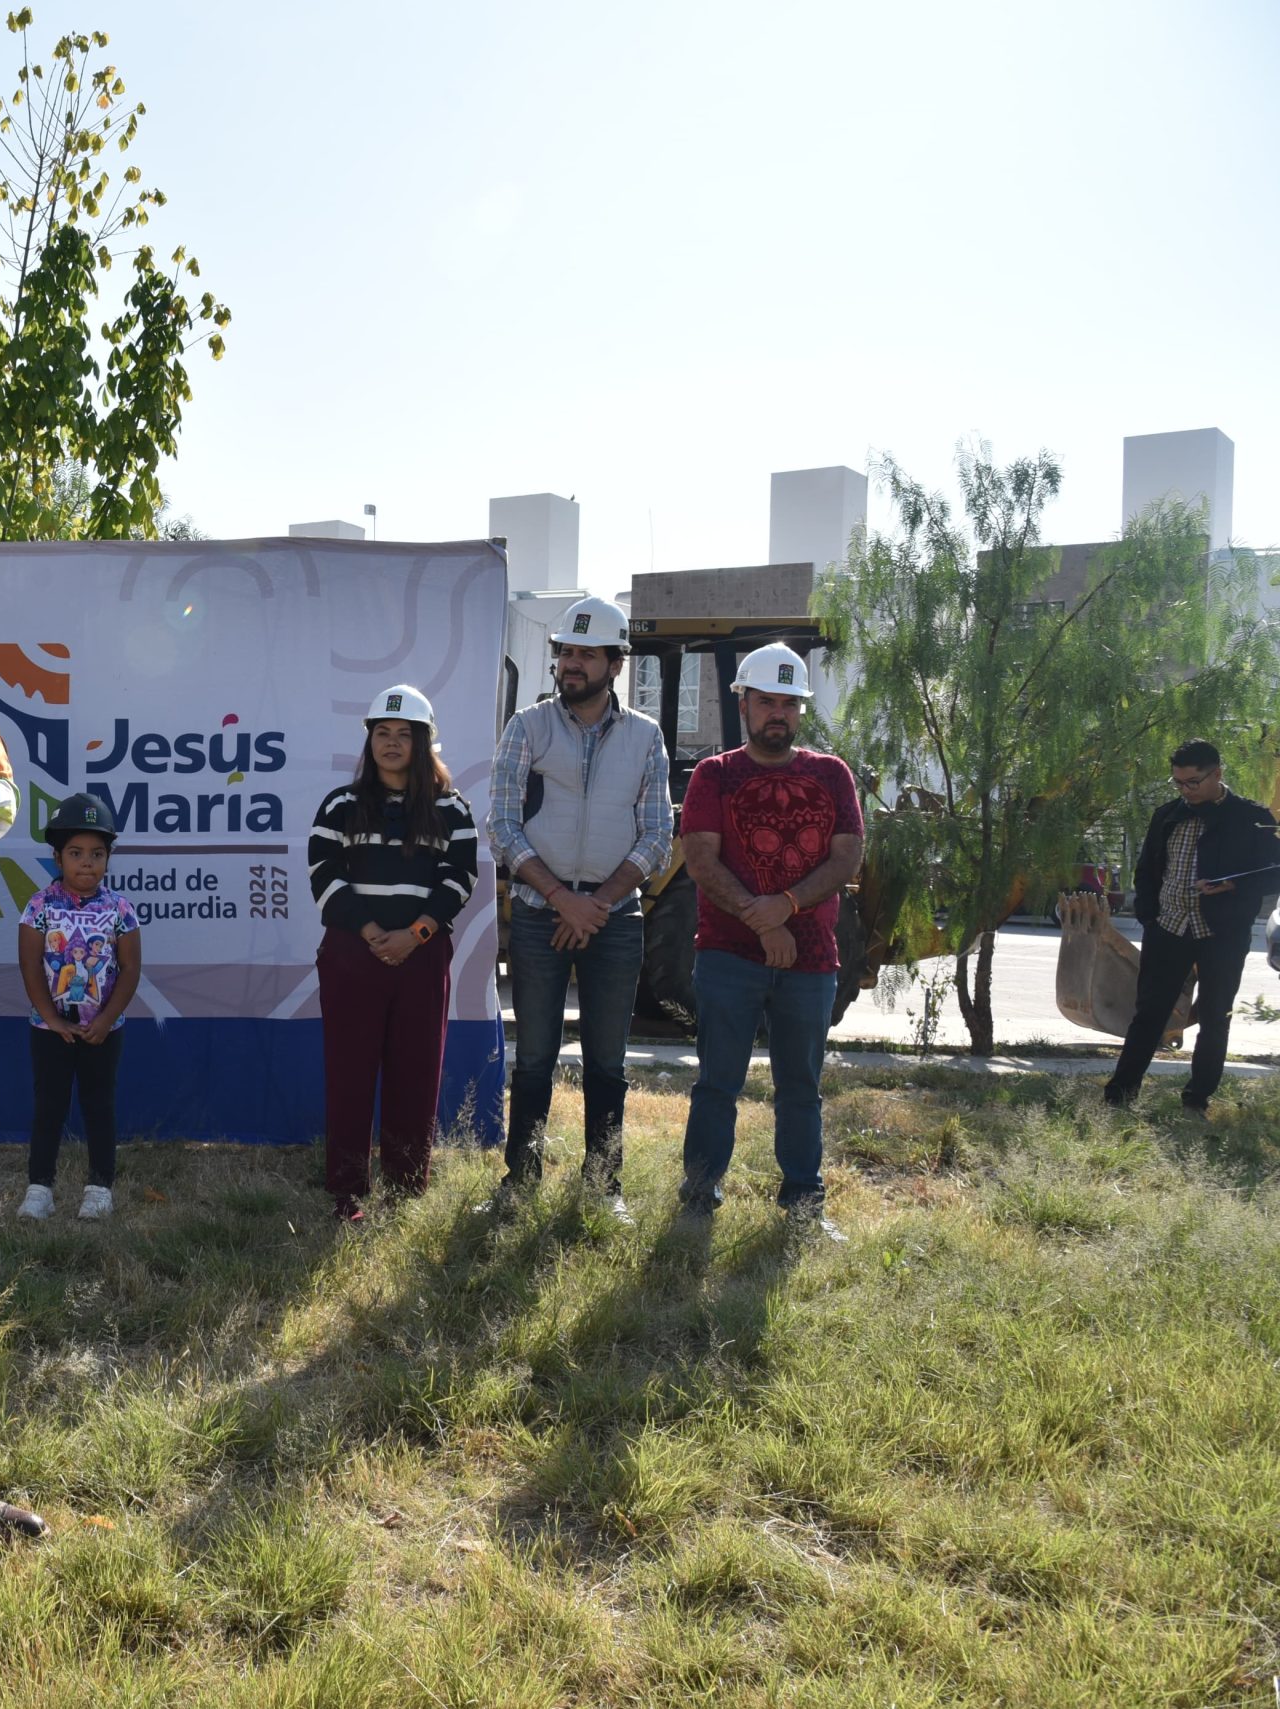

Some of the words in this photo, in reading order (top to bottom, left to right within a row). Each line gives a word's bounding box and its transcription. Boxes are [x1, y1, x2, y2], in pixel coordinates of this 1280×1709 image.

[629, 621, 649, 632] 16C
[86, 713, 287, 774] Jesús
[86, 771, 283, 833] María
[103, 868, 176, 891] iudad
[185, 868, 218, 891] de
[249, 864, 267, 919] 2024
[271, 866, 289, 919] 2027
[130, 896, 237, 925] guardia
